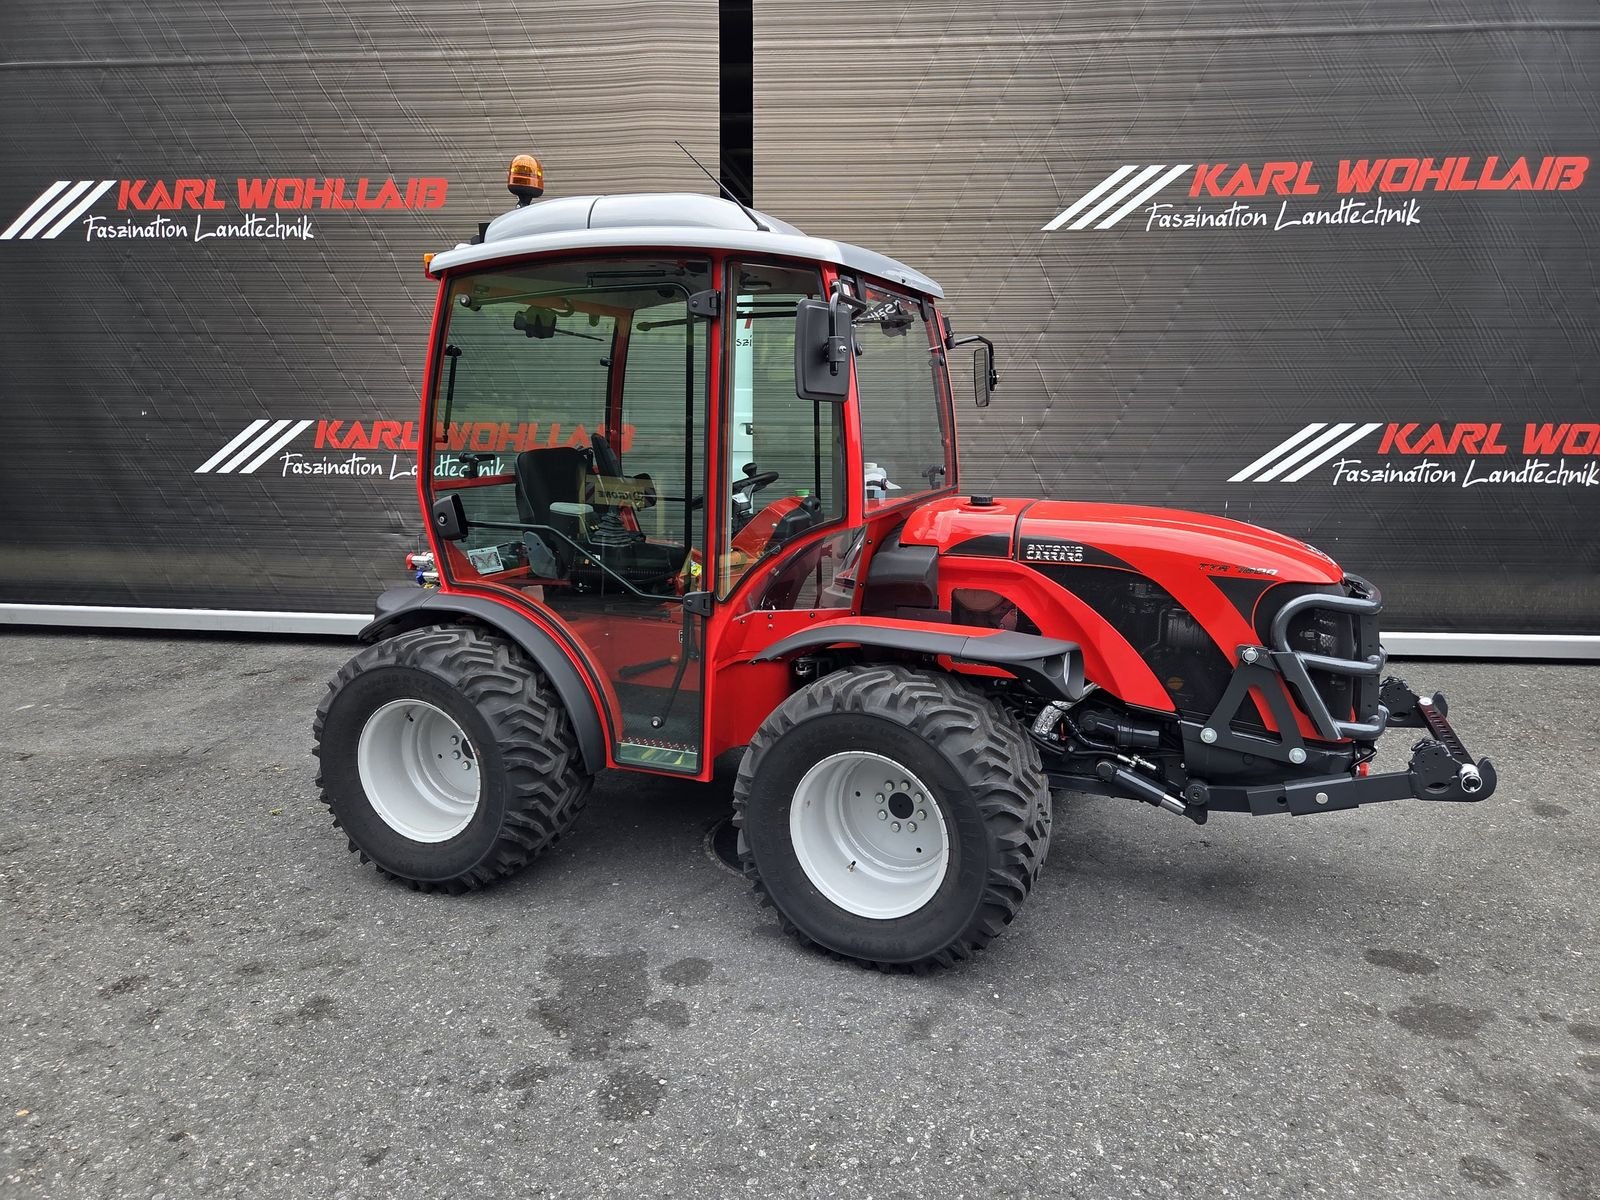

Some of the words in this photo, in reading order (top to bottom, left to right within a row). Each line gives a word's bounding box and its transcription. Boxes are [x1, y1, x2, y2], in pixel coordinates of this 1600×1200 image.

[117, 177, 226, 210] KARL
[1190, 161, 1320, 197] KARL
[83, 214, 188, 242] Faszination
[195, 213, 314, 242] Landtechnik
[1145, 201, 1267, 232] Faszination
[1274, 196, 1420, 232] Landtechnik
[314, 419, 418, 450] KARL
[1377, 422, 1508, 455] KARL
[1522, 422, 1600, 455] WO
[280, 451, 383, 478] Faszination
[390, 453, 504, 481] Ladtecnik
[1333, 457, 1456, 486] Faszination
[1462, 459, 1600, 487] Landtechnik
[1026, 544, 1083, 552] ANTONIO
[1026, 551, 1083, 562] CARRARO
